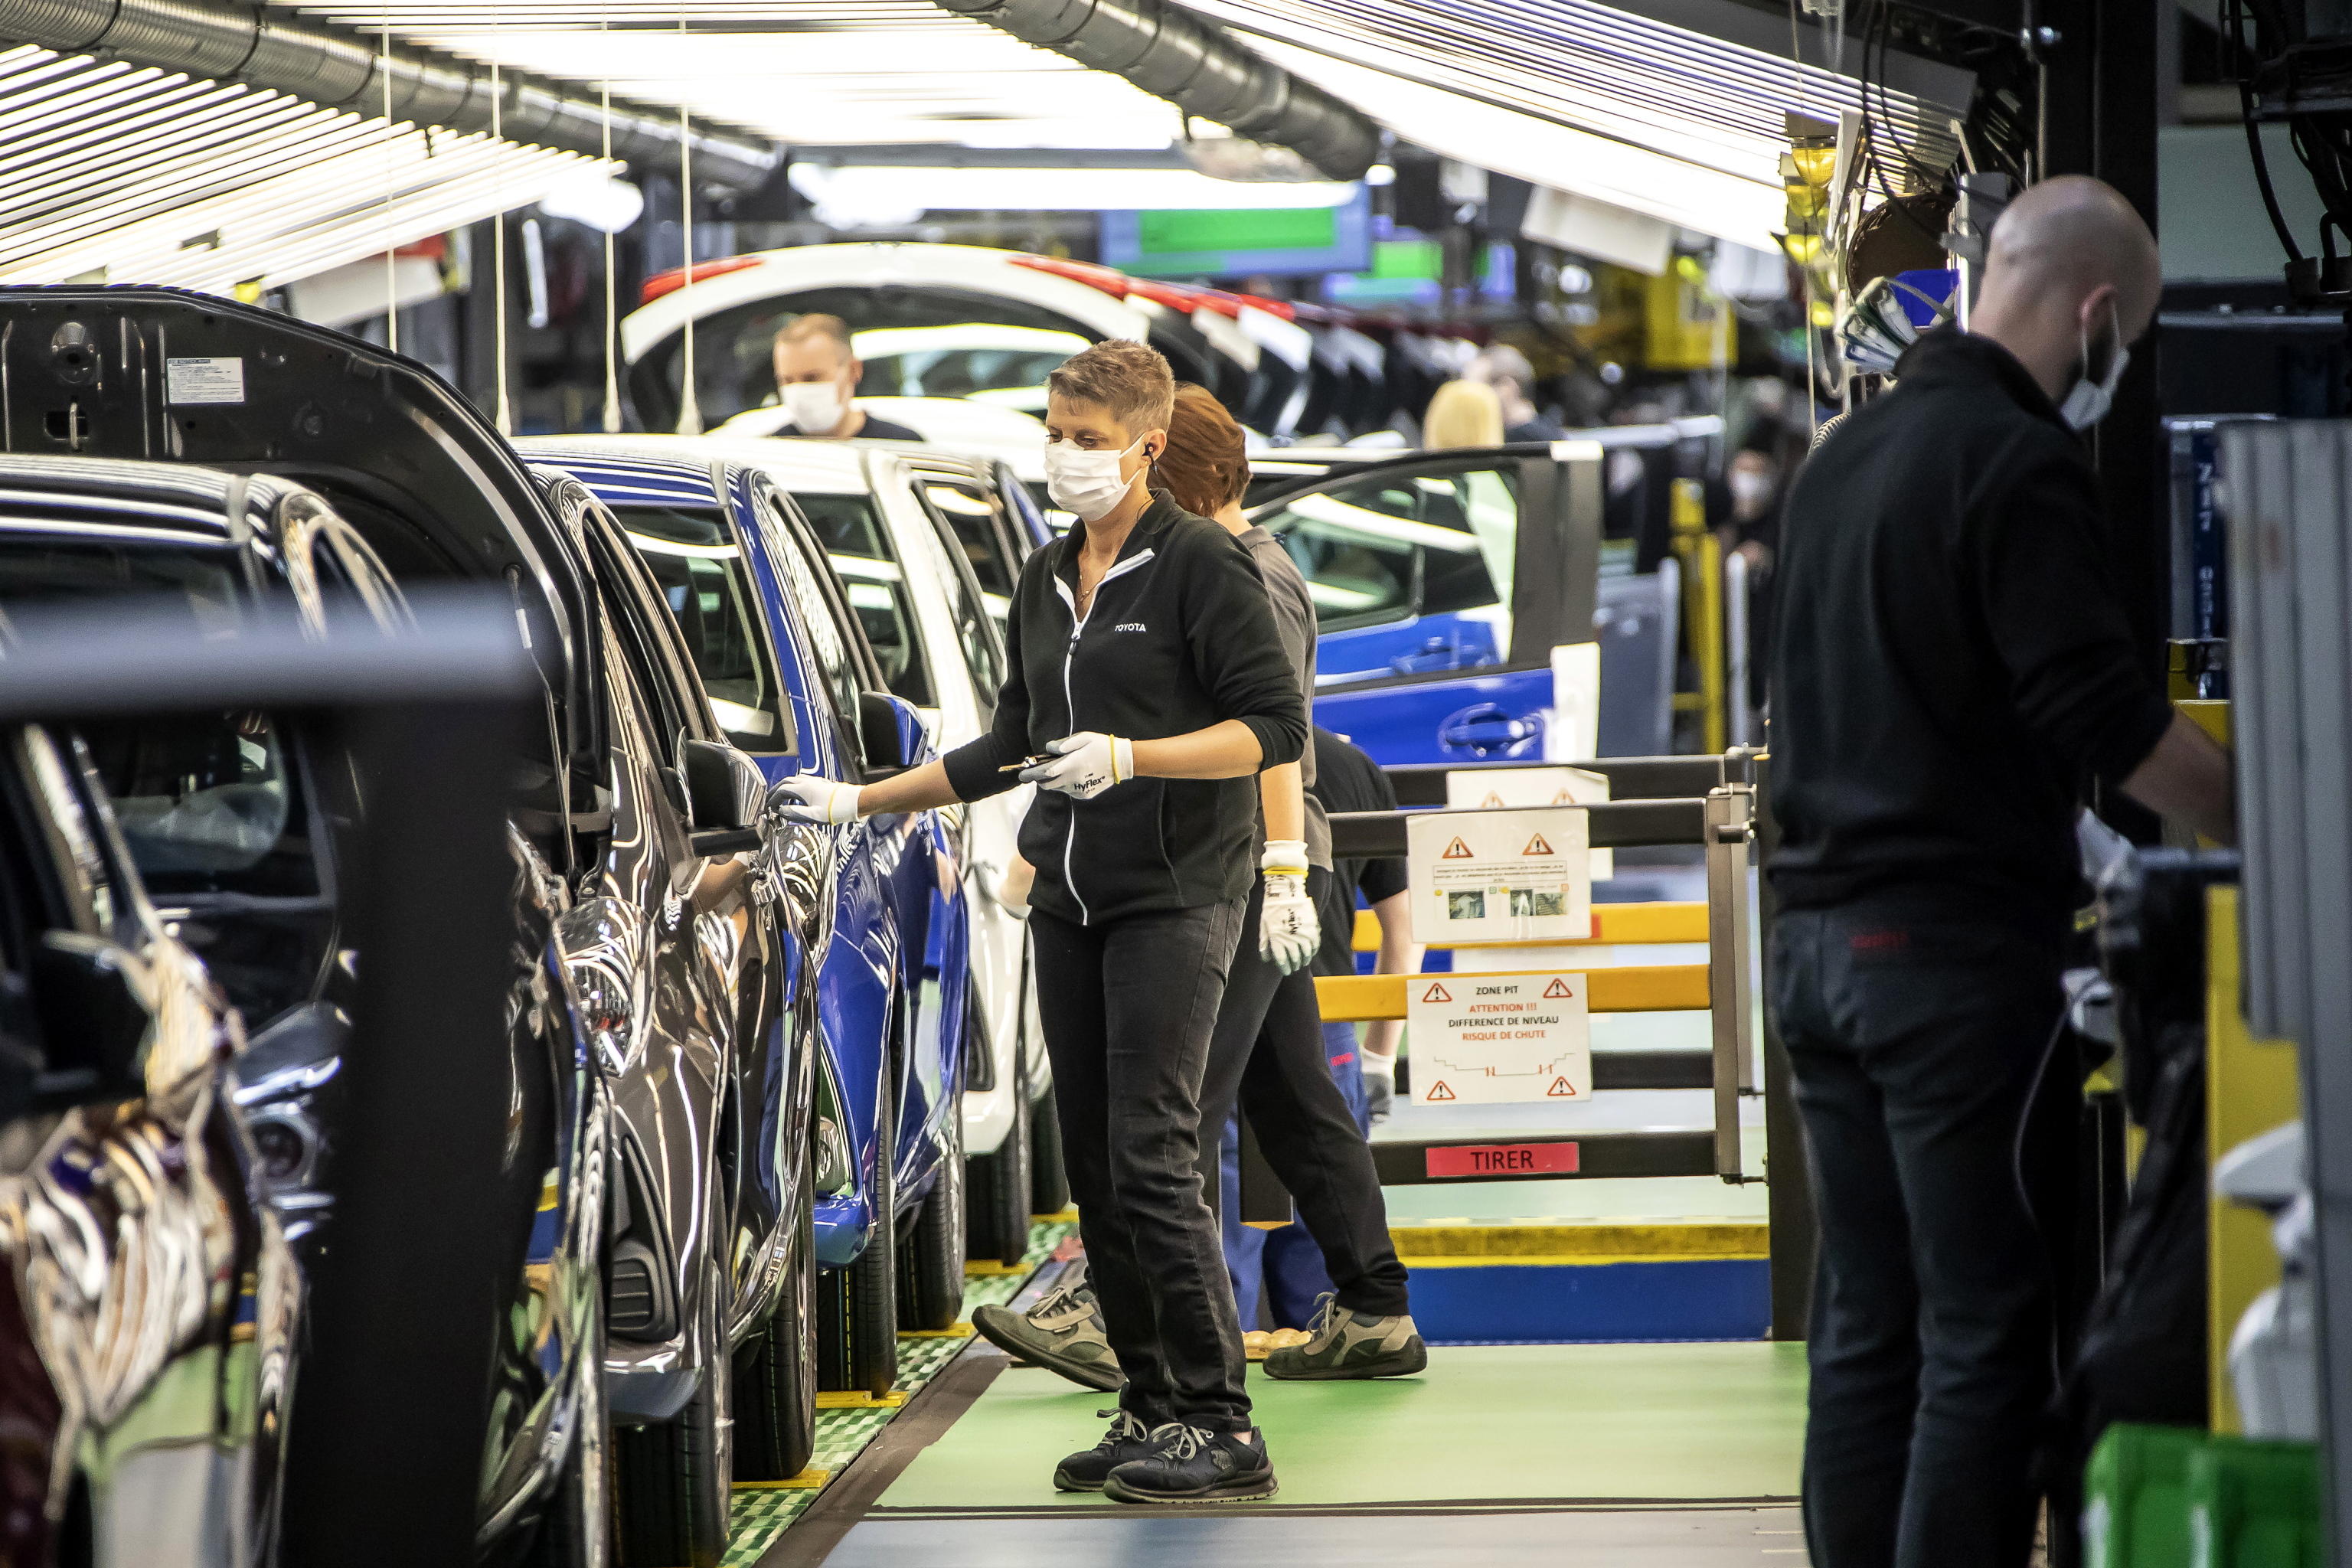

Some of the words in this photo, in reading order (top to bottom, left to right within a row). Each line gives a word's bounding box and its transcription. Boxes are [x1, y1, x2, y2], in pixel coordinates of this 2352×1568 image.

[1115, 623, 1146, 632] TOYOTA
[1074, 778, 1102, 792] HyFlex
[1476, 985, 1501, 995] ZONE
[1504, 985, 1519, 995] PIT
[1469, 1004, 1524, 1013] ATTENTION
[1449, 1018, 1504, 1027] DIFFERENCE
[1508, 1017, 1520, 1026] DE
[1522, 1015, 1560, 1025] NIVEAU
[1462, 1031, 1497, 1041] RISQUE
[1500, 1031, 1512, 1040] DE
[1515, 1030, 1547, 1040] CHUTE
[1470, 1150, 1534, 1171] TIRER
